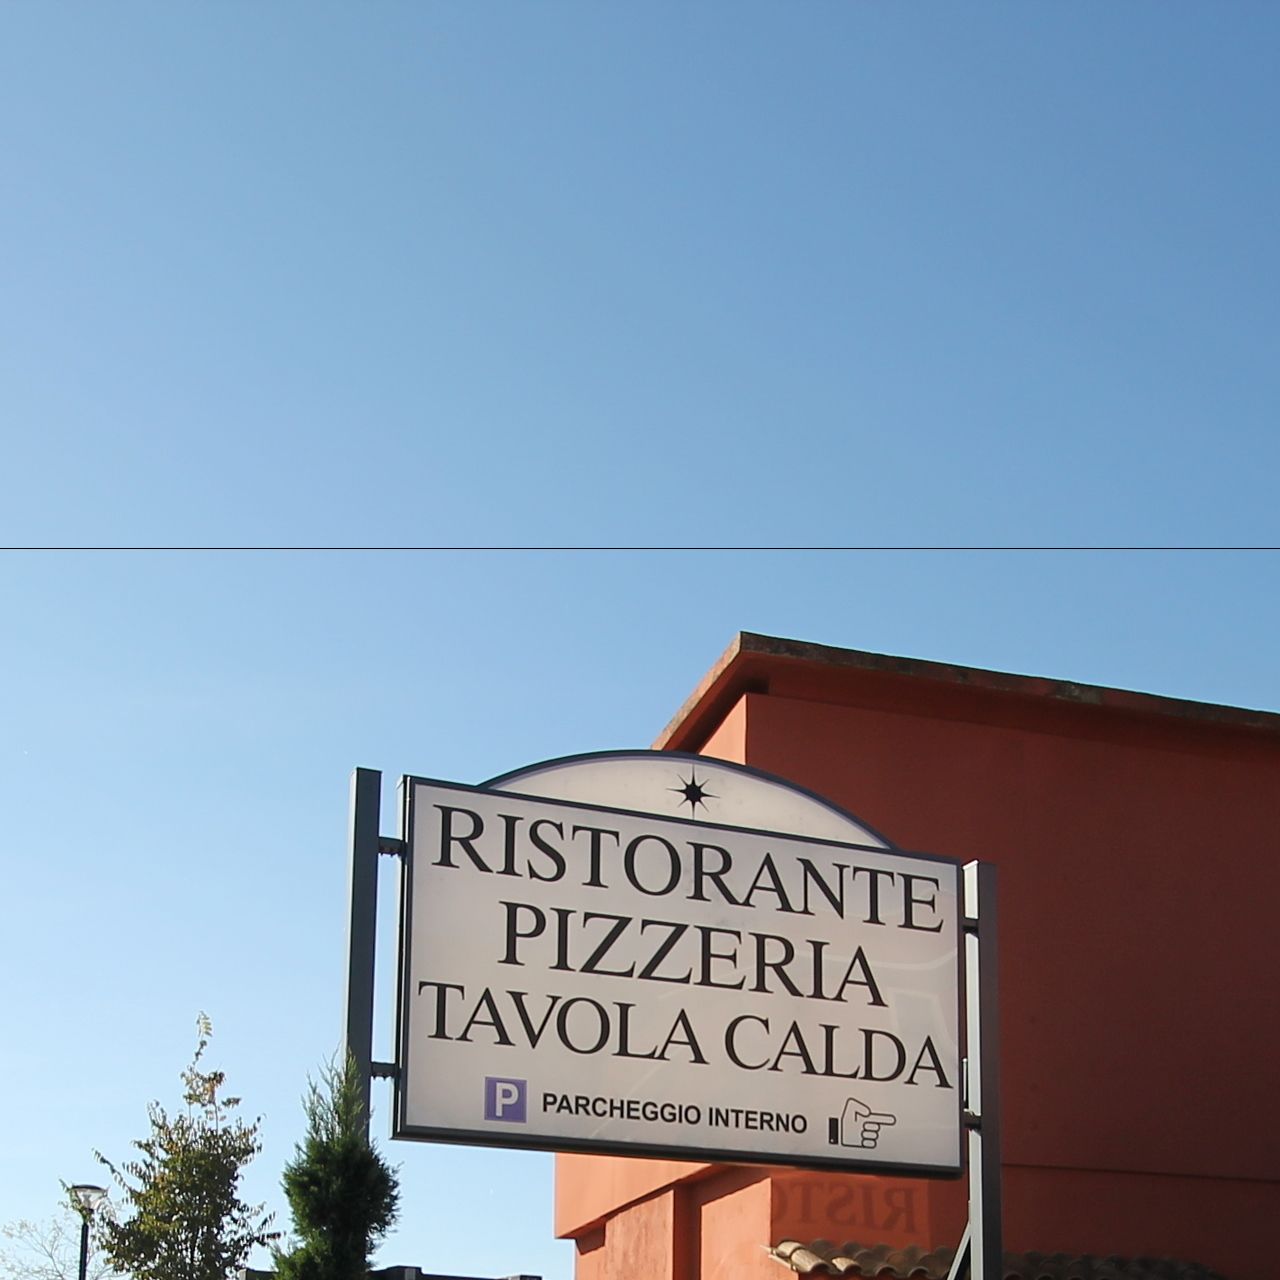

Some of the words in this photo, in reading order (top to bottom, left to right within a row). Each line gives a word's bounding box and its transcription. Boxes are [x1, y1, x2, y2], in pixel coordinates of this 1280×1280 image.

[432, 803, 945, 934] RISTORANTE
[497, 901, 889, 1007] PIZZERIA
[417, 981, 710, 1066] TAVOLA
[723, 1014, 953, 1089] CALDA
[494, 1082, 521, 1117] P
[542, 1091, 702, 1127] PARCHEGGIO
[707, 1106, 808, 1135] INTERNO
